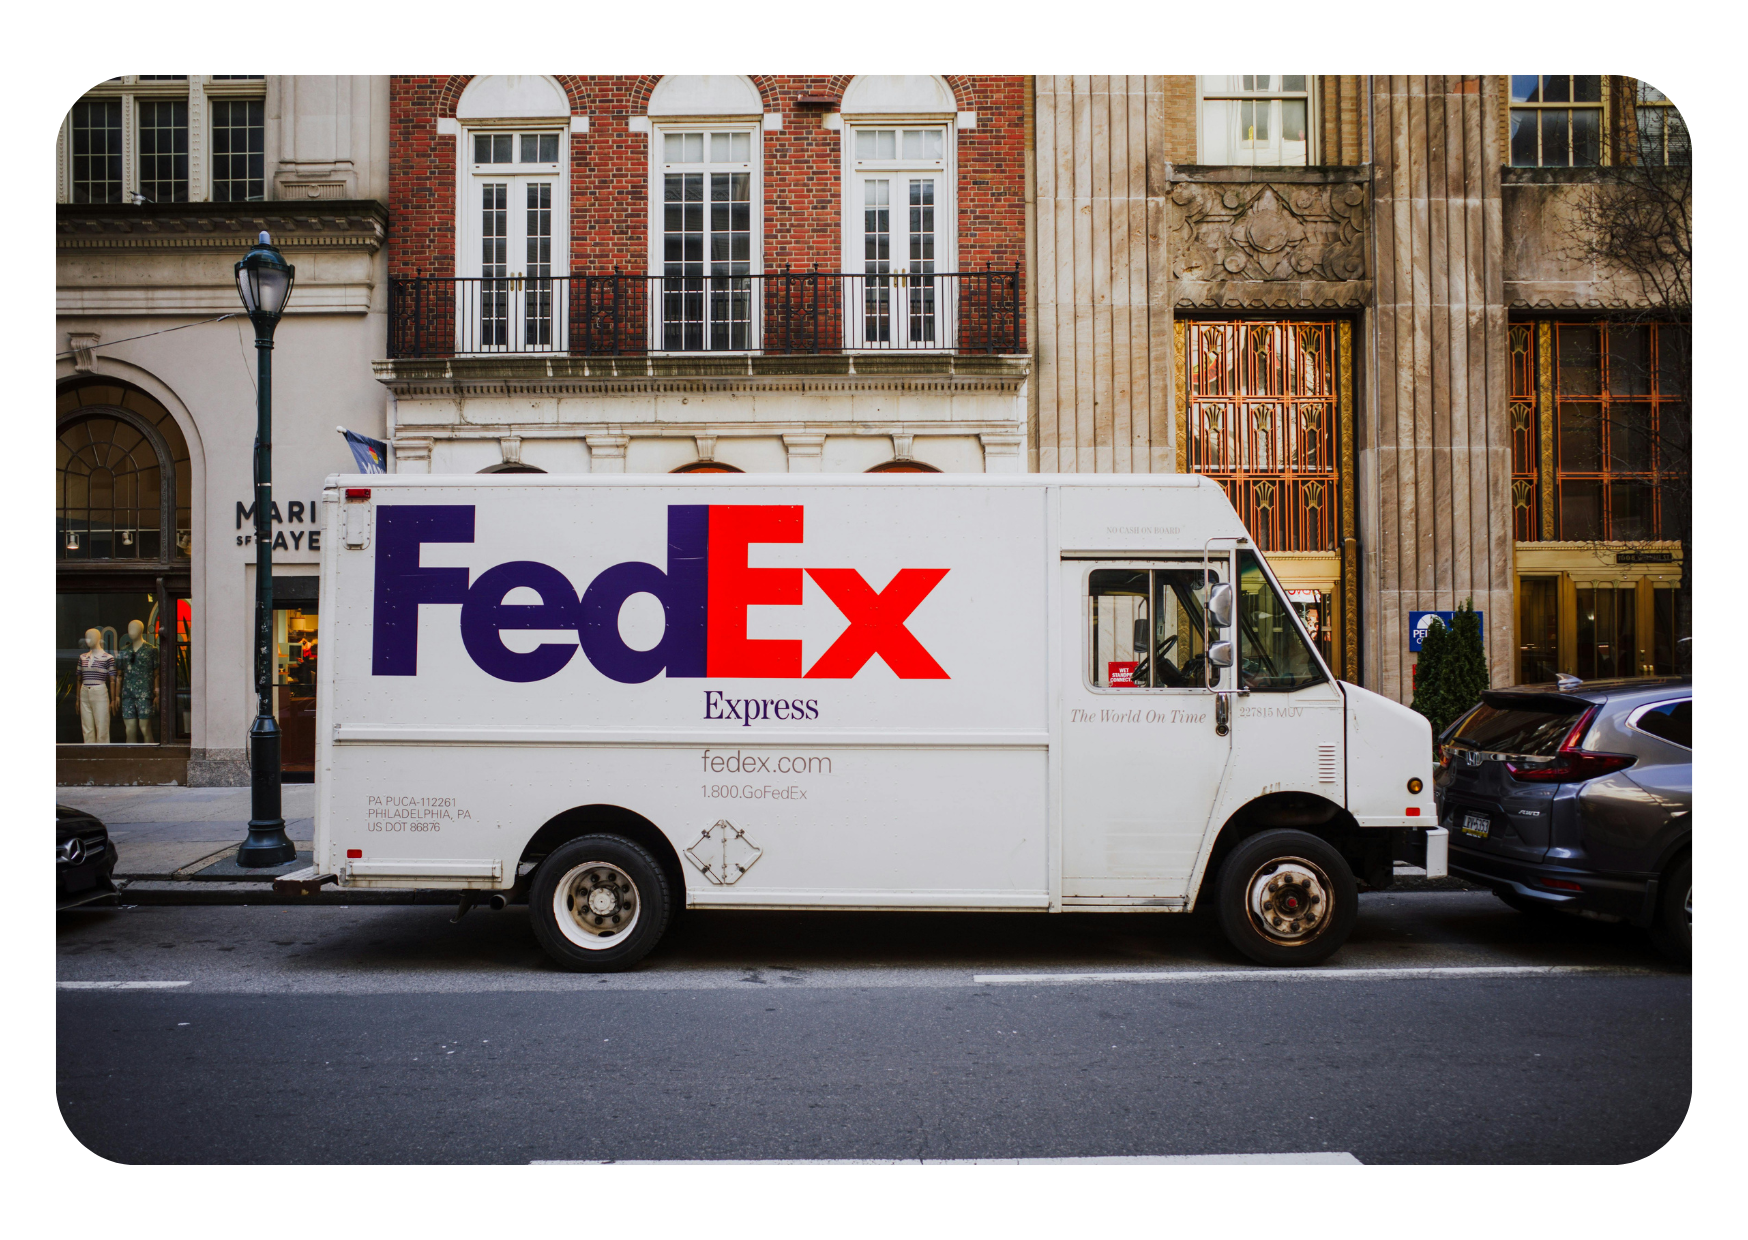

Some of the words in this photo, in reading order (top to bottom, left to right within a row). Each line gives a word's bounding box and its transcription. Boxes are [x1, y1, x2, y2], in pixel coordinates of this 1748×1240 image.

[236, 500, 316, 530] MARI
[1106, 526, 1118, 534] NO
[1119, 526, 1140, 534] CASH
[1140, 526, 1152, 534] ON
[1154, 526, 1181, 535] BOARD
[272, 530, 321, 551] AYE
[372, 504, 951, 684] FedEx
[703, 690, 819, 727] Express
[1070, 708, 1096, 723] The
[1100, 709, 1142, 723] World
[1145, 710, 1167, 723] On
[1170, 709, 1207, 724] Time
[1239, 706, 1274, 718] 227815
[1276, 706, 1304, 718] MUV
[701, 749, 832, 774] fedex.com
[701, 784, 808, 800] 1.800.GoFedEx
[368, 795, 383, 806] PA
[385, 796, 456, 807] PUCA-112261
[368, 808, 453, 820] PHILADELPHIA,
[457, 809, 472, 820] PA
[367, 821, 383, 832] US
[385, 821, 408, 832] DOT
[409, 822, 441, 832] 86876
